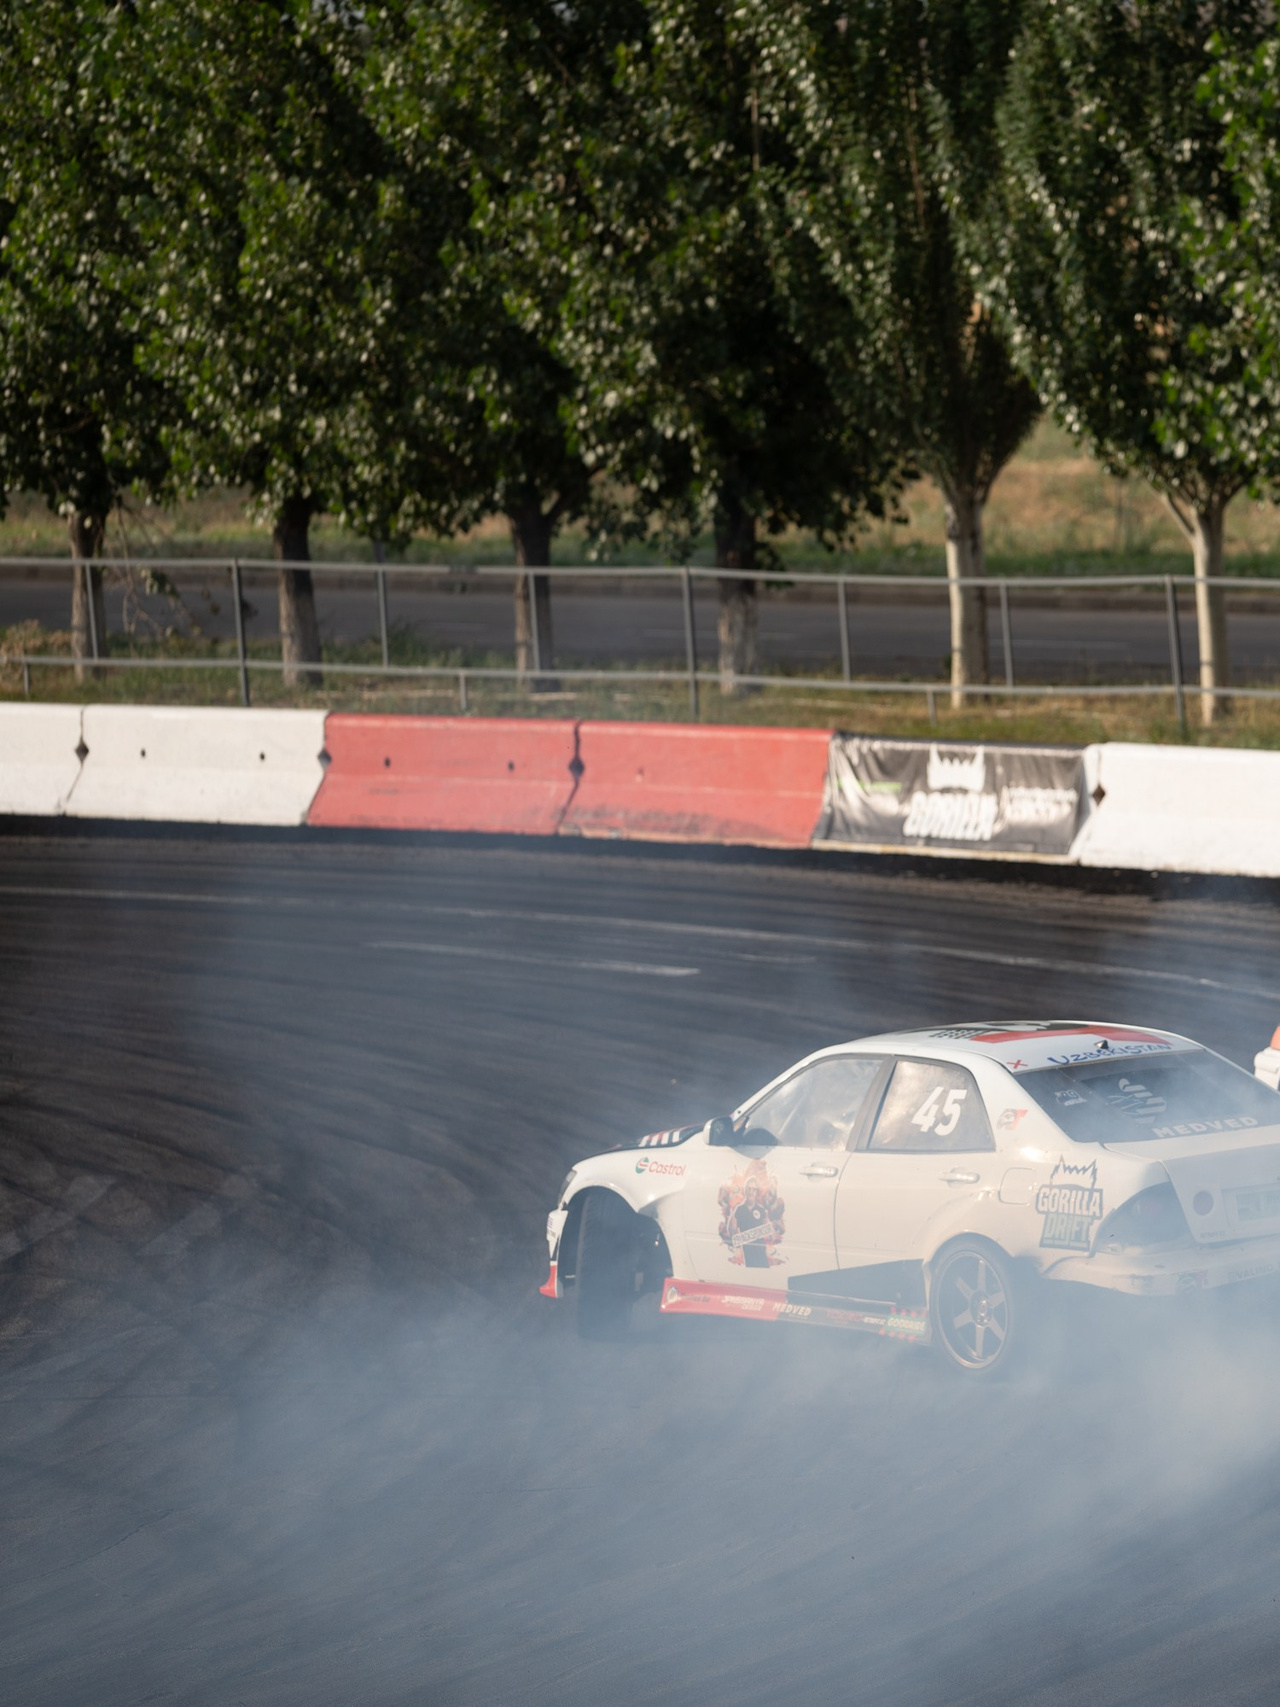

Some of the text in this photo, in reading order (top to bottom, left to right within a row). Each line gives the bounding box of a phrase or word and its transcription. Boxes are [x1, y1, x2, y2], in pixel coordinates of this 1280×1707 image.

[1047, 1042, 1173, 1067] UZBEKISTAN
[911, 1086, 967, 1137] 45
[1152, 1116, 1260, 1139] MEDVED
[648, 1160, 686, 1176] Castrol
[1037, 1187, 1103, 1216] GORILLA
[1043, 1216, 1091, 1240] DRIFT
[772, 1302, 811, 1317] MEDVED
